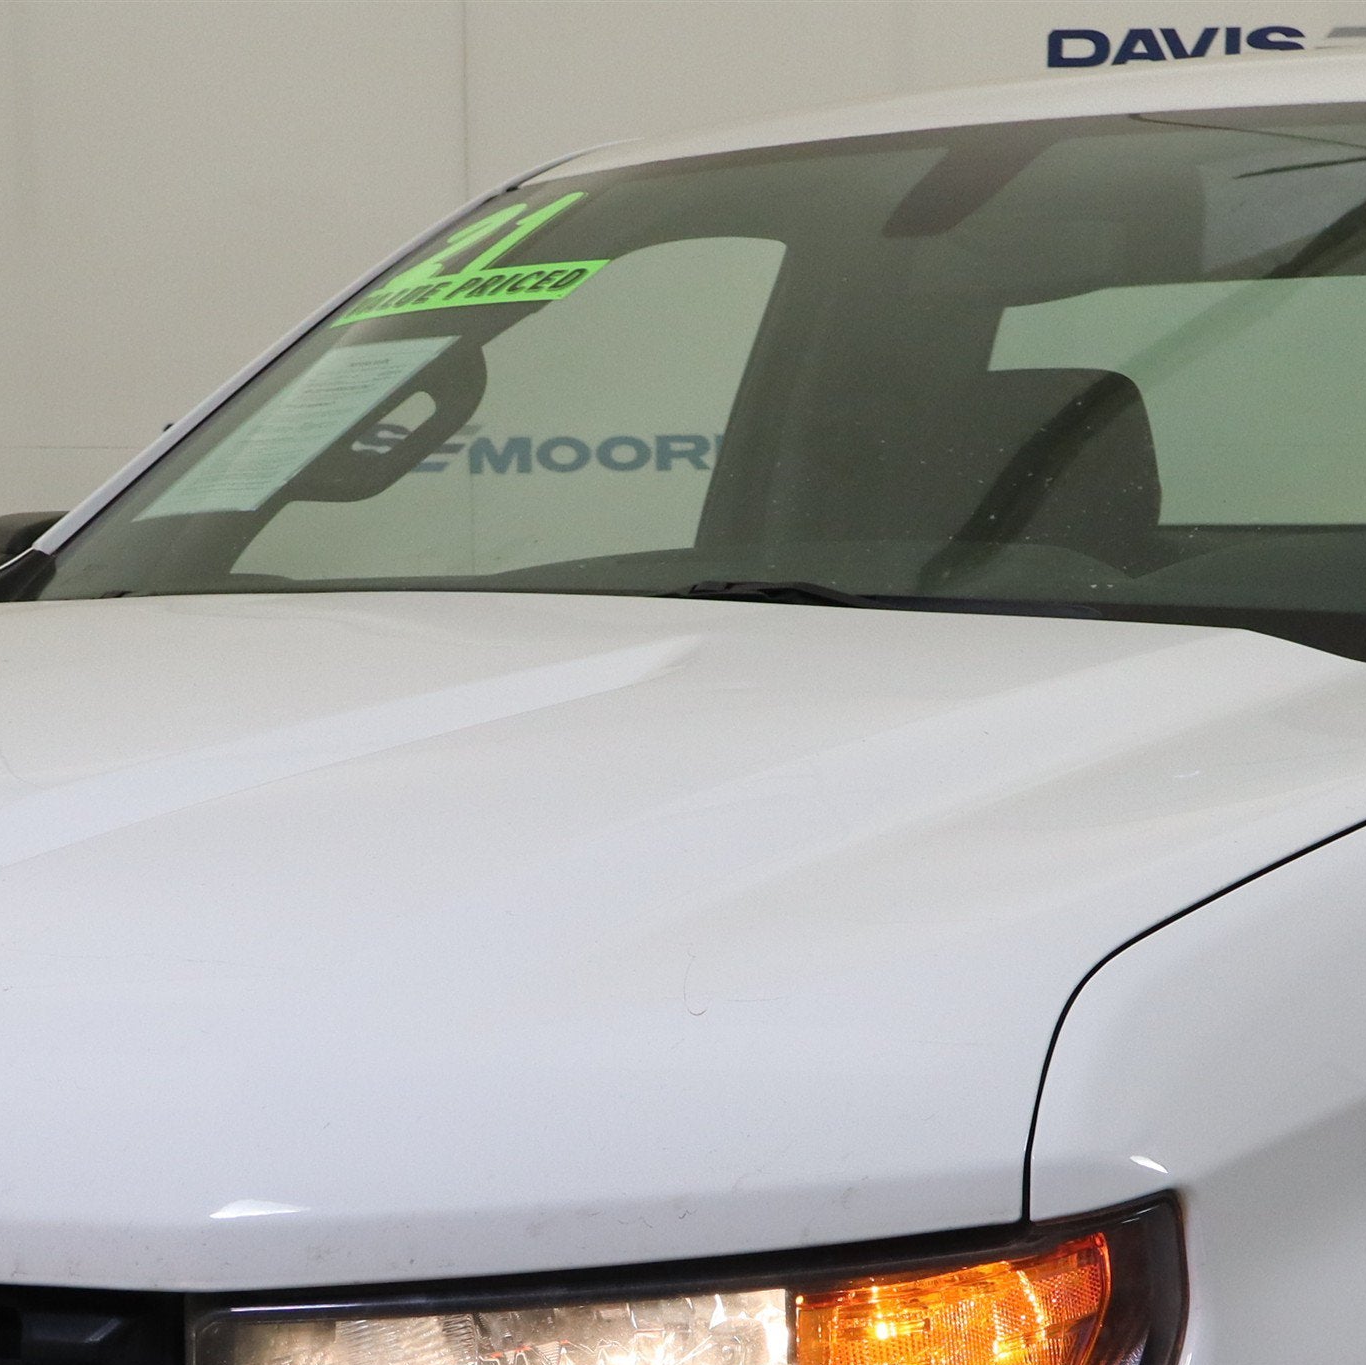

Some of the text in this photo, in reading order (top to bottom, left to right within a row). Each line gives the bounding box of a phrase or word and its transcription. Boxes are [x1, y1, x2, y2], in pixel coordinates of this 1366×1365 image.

[1047, 26, 1306, 67] DAVIS
[443, 267, 589, 301] PRICED
[468, 435, 726, 474] MOOR
